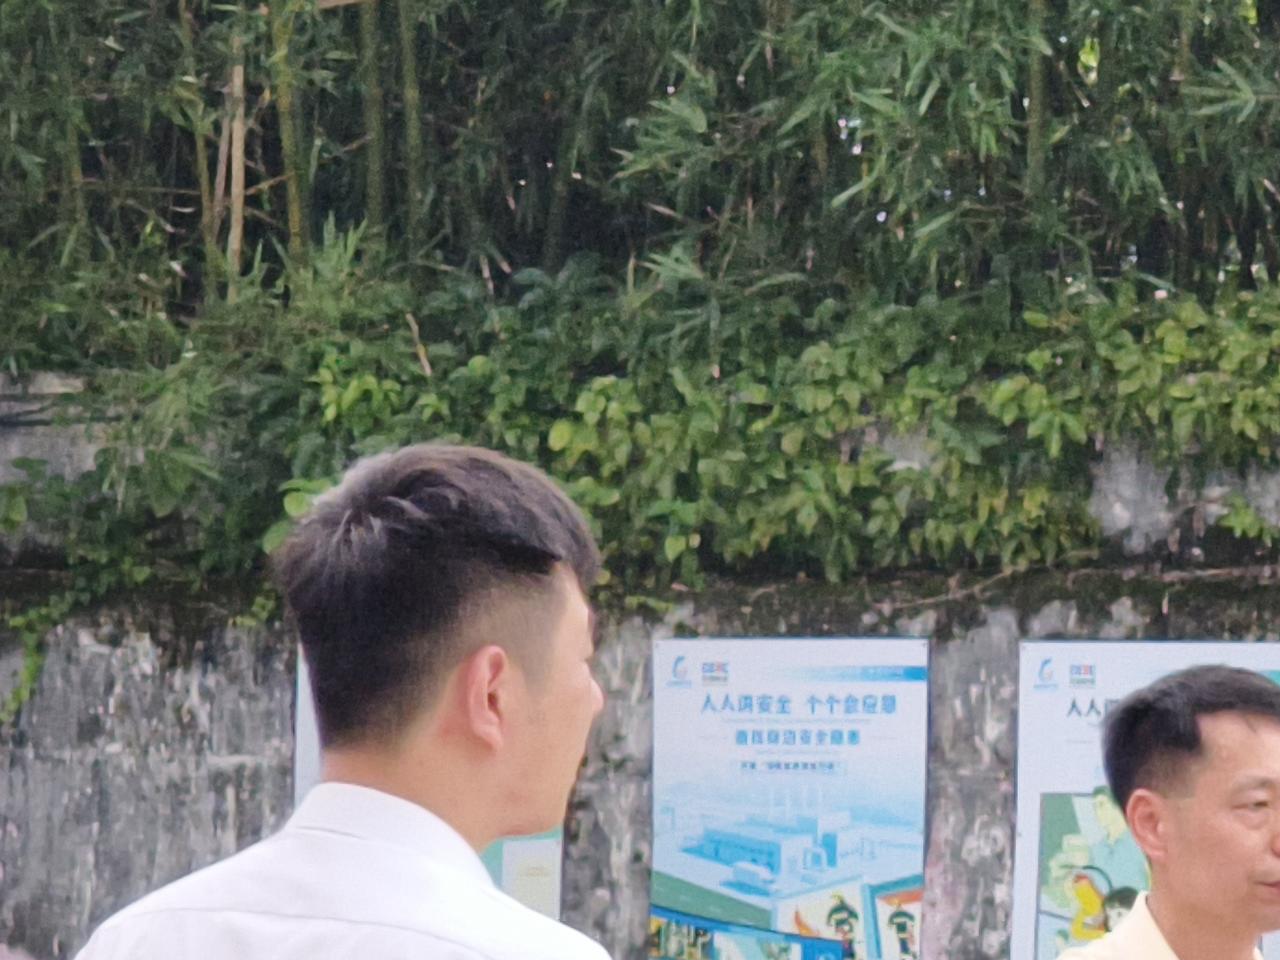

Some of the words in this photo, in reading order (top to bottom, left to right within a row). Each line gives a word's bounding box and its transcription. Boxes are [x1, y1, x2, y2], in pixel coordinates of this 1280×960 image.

[701, 694, 791, 714] 人人讲安全
